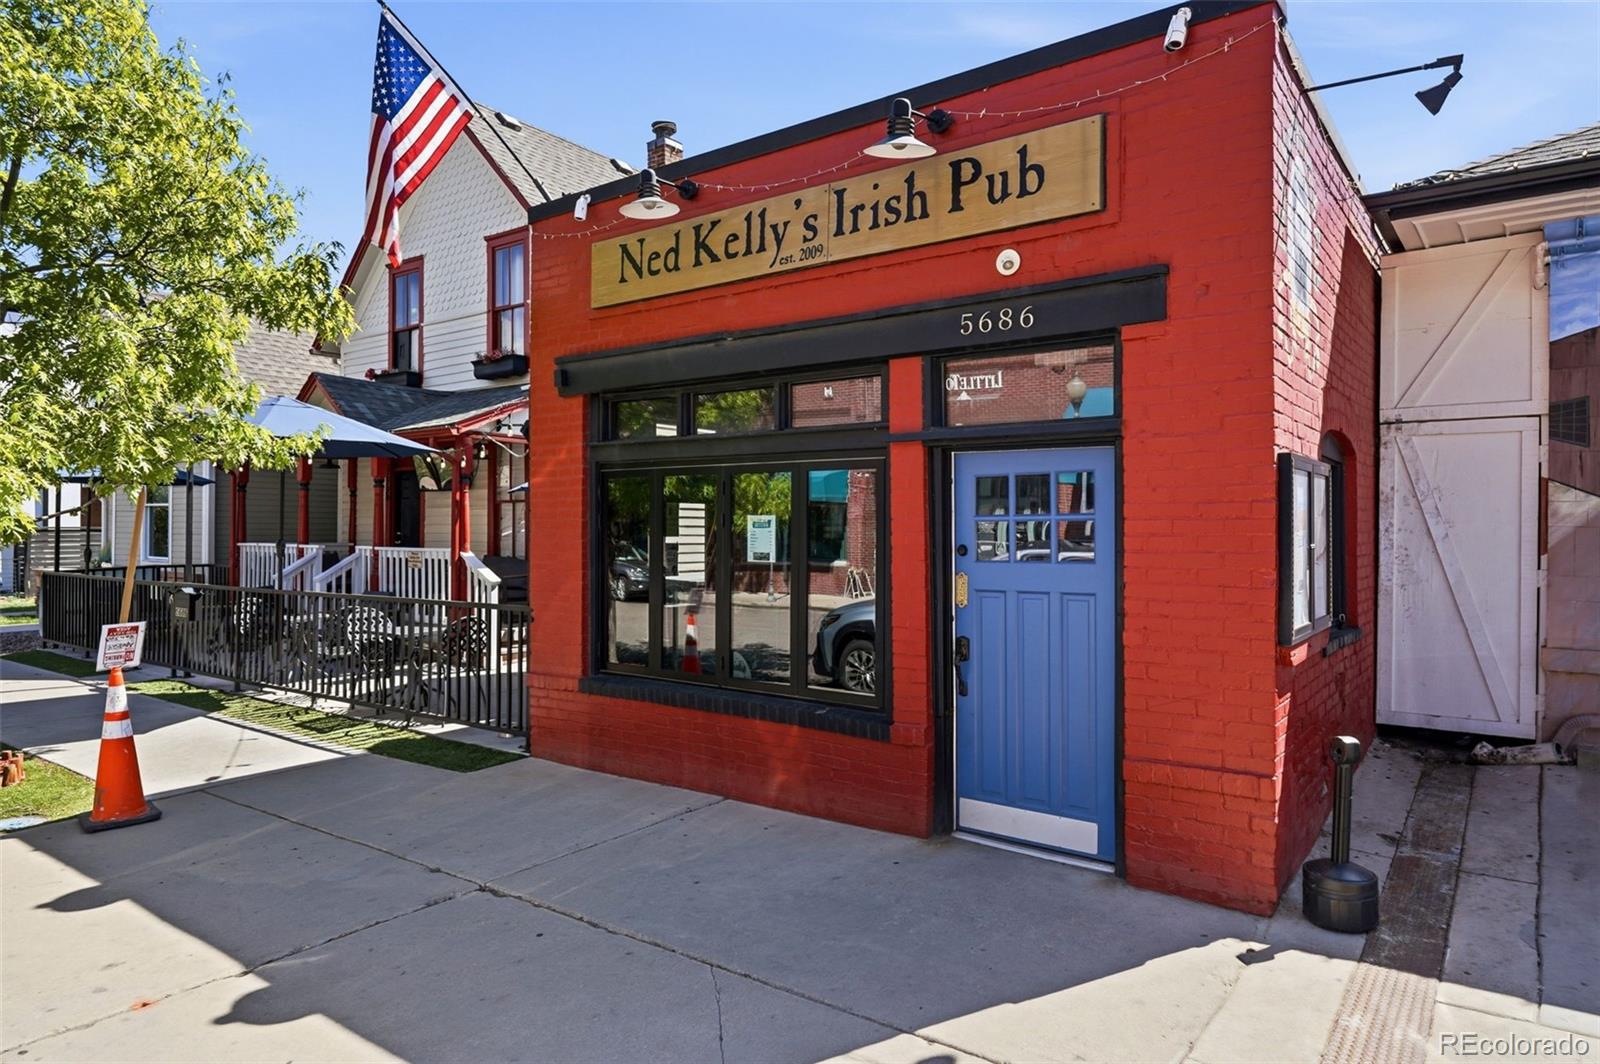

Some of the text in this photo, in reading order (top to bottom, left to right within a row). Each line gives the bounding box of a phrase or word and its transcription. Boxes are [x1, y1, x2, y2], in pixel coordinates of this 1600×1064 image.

[618, 143, 1046, 284] Ned Kelly's Irish Pub
[779, 243, 824, 266] est. 2009
[960, 305, 1035, 336] 5686
